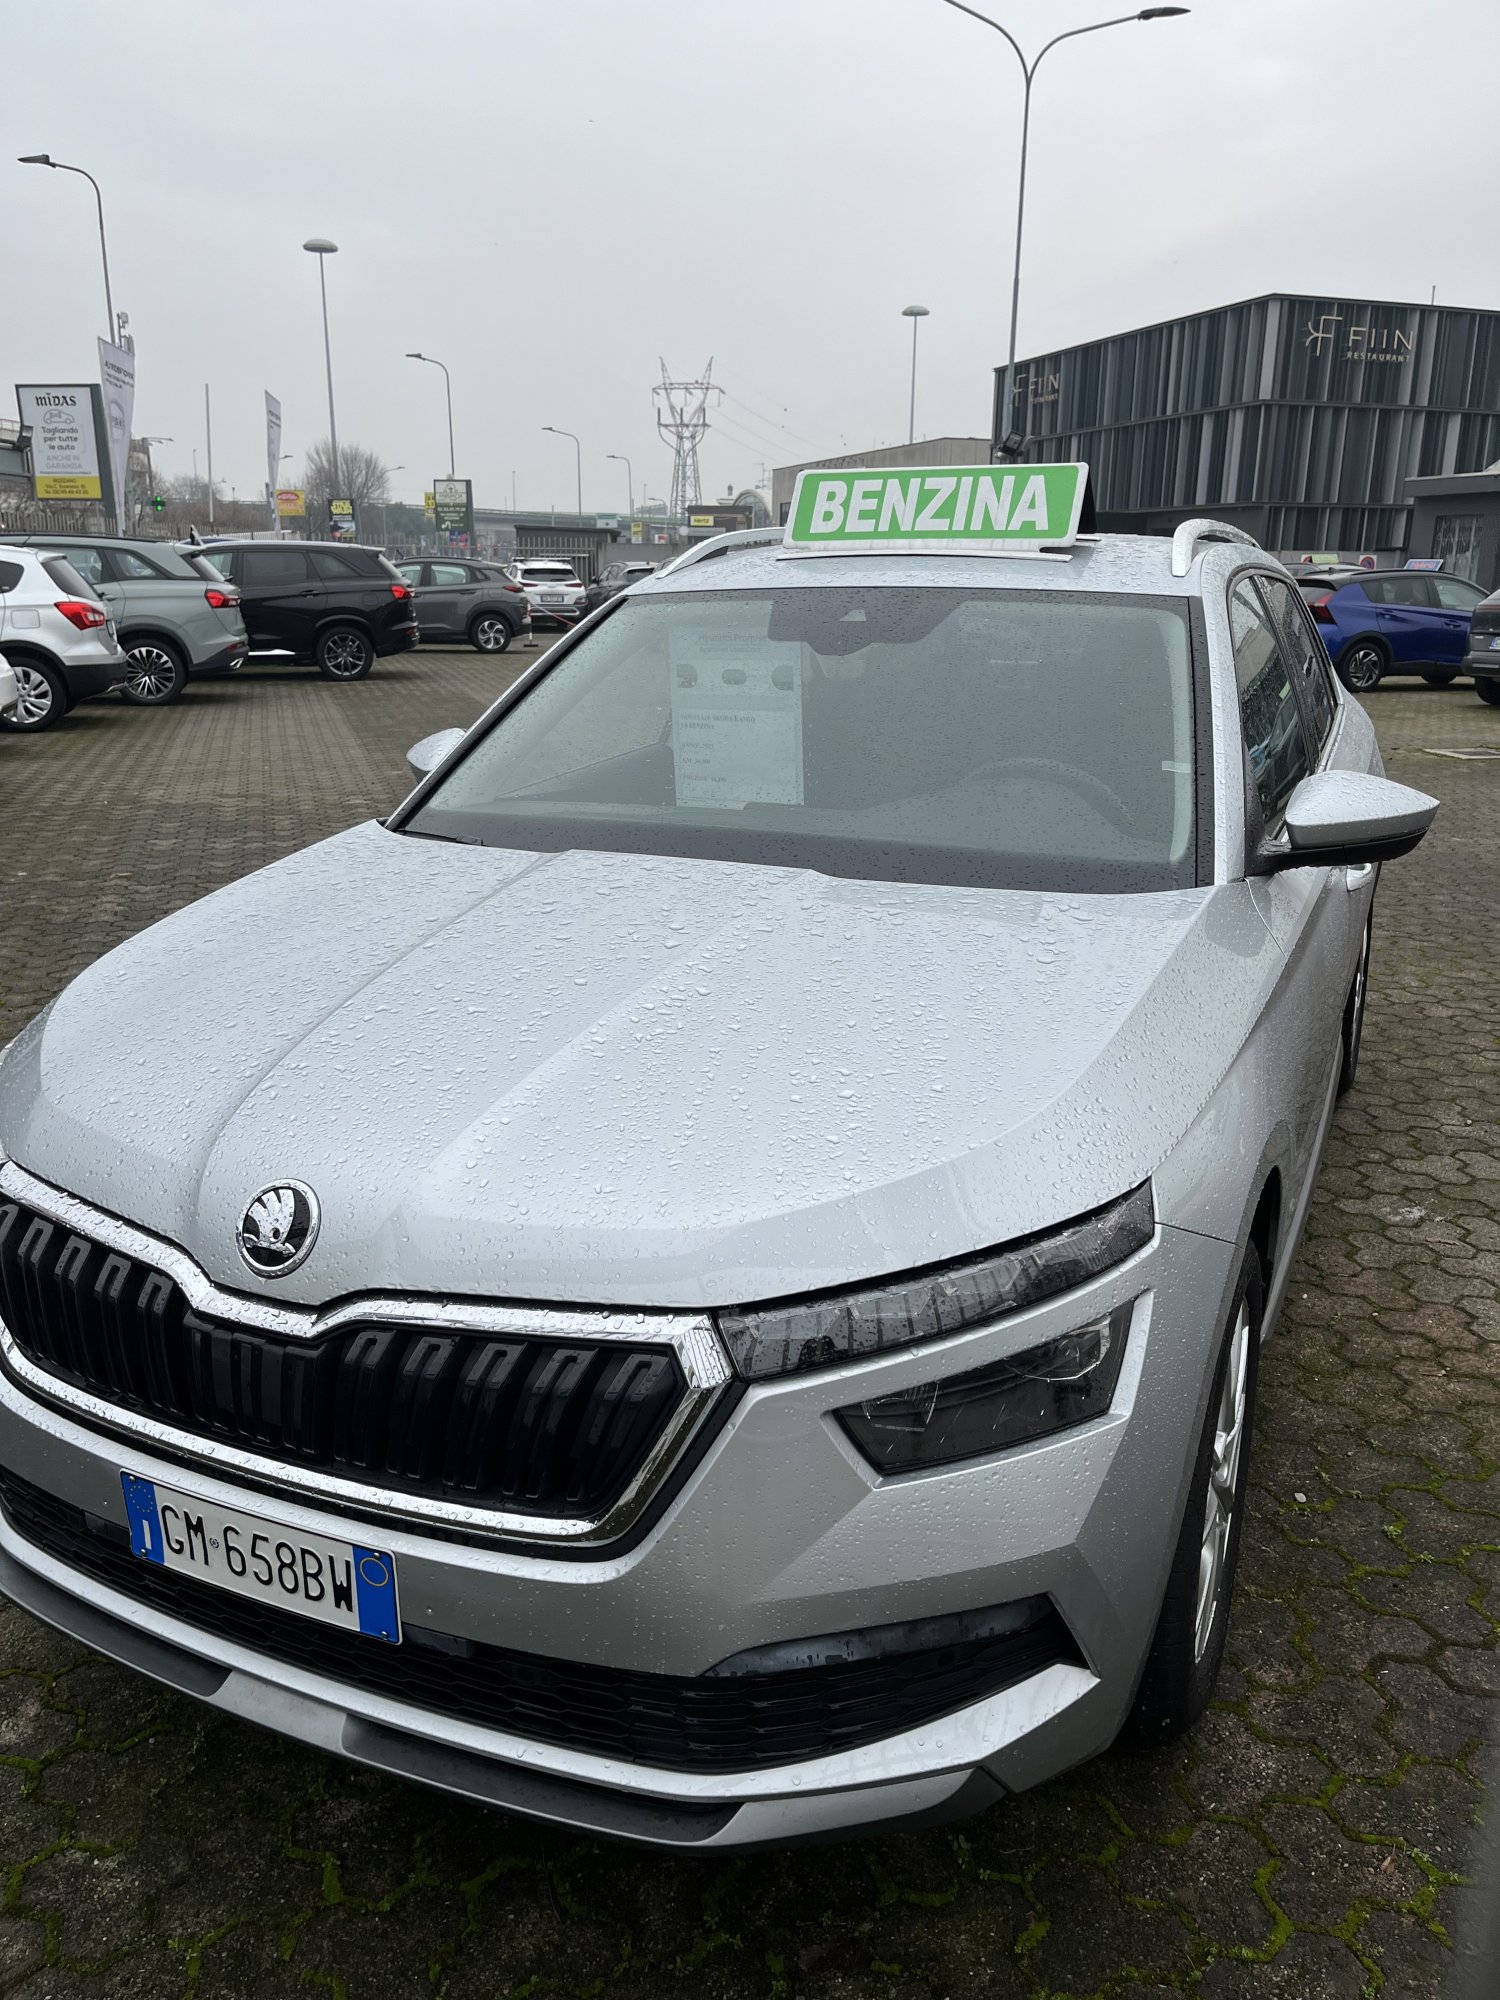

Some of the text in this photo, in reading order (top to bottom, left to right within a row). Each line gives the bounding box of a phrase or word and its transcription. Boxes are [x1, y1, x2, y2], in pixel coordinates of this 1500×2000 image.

[1348, 326, 1414, 351] FIIN
[1346, 351, 1410, 363] RESTAURANT
[1029, 373, 1060, 396] FIIN
[35, 392, 77, 407] MIDAS
[41, 426, 79, 436] Tagliando
[58, 434, 78, 442] tutte
[809, 474, 1049, 534] BENZINA
[223, 1524, 355, 1613] 658BW
